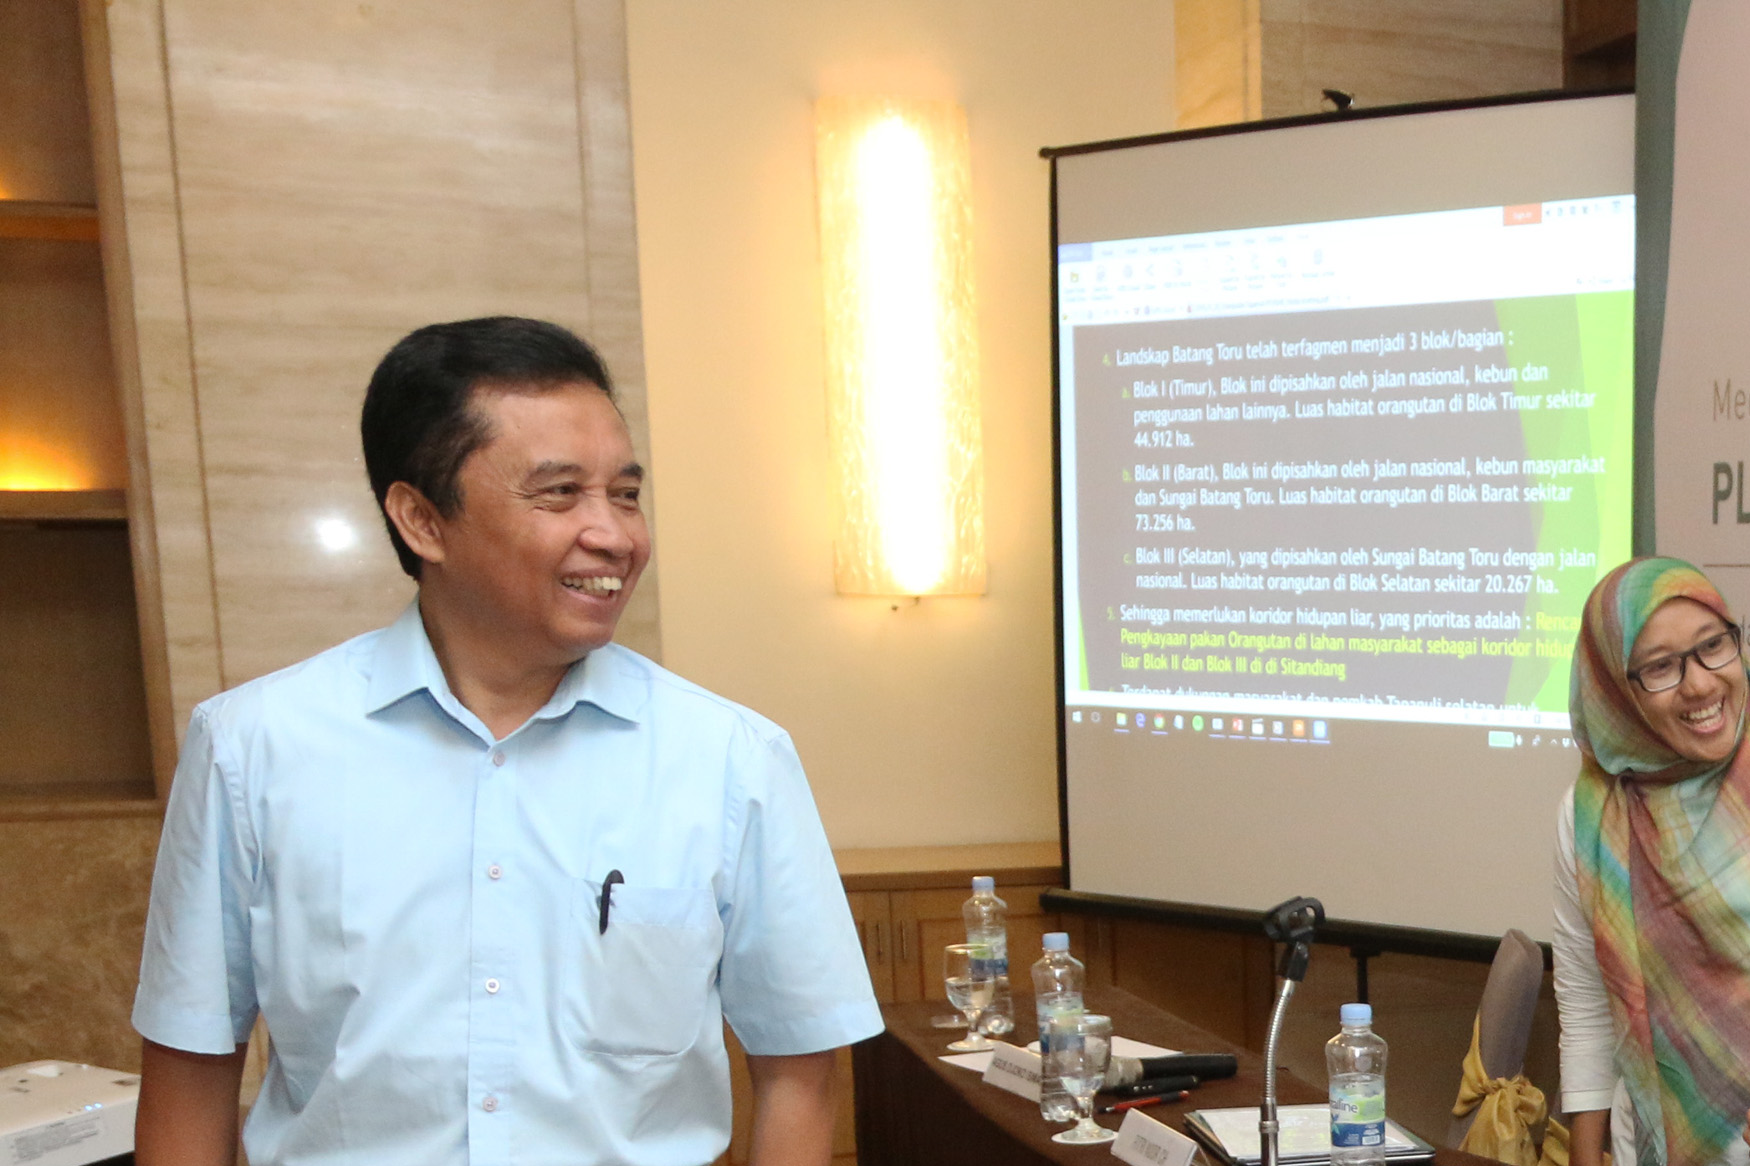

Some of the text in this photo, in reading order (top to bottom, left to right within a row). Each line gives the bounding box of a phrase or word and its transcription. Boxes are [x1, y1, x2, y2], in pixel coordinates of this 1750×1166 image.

[1116, 348, 1168, 366] Landskap
[1172, 345, 1214, 366] Batang
[1216, 343, 1242, 360] Toru
[1246, 341, 1277, 358] telah
[1282, 338, 1347, 360] terfagmen
[1352, 333, 1404, 356] menjadi
[1410, 332, 1417, 350] 3
[1422, 329, 1503, 351] blok/bagian
[1134, 381, 1157, 398] Blok
[1221, 377, 1246, 394] Blok
[1251, 376, 1265, 392] ini
[1269, 373, 1335, 395] dipisahkan
[1339, 371, 1367, 388] oleh
[1372, 370, 1405, 392] jalan
[1410, 366, 1470, 386] nasional,
[1475, 364, 1517, 383] kebun
[1522, 363, 1548, 381] dan
[1134, 390, 1597, 427] penggunaan lahan lainnya. Luas habitat orangutan di Blok Timur sekitar
[1134, 430, 1193, 447] 44.912 ha.
[1135, 464, 1159, 481] Blok
[1163, 464, 1169, 480] II
[1174, 464, 1218, 483] (Barat),
[1223, 463, 1248, 480] Blok
[1253, 463, 1268, 479] ini
[1271, 461, 1337, 482] dipisahkan
[1341, 460, 1369, 478] oleh
[1373, 459, 1406, 481] jalan
[1411, 458, 1470, 478] nasional,
[1476, 457, 1518, 474] kebun
[1523, 455, 1605, 478] masyarakat
[1135, 483, 1573, 510] dan Sungai Batang Toru. Luas habitat orangutan di Blok Barat sekitar
[1136, 514, 1195, 531] 73.256 ha.
[1136, 548, 1160, 564] Blok
[1164, 548, 1174, 564] III
[1178, 547, 1234, 567] (Selatan),
[1239, 551, 1267, 569] yang
[1271, 549, 1337, 568] dipisahkan
[1340, 549, 1368, 565] oleh
[1373, 548, 1414, 570] Sungai
[1419, 549, 1465, 570] Batang
[1469, 548, 1498, 566] Toru
[1503, 548, 1554, 570] dengan
[1558, 550, 1595, 571] jalan
[1136, 572, 1558, 595] nasional. Luas habitat orangutan di Blok Selatan sekitar 20.267 ha.
[1120, 604, 1169, 625] Sehingga
[1174, 607, 1245, 624] memerlukan
[1249, 607, 1292, 625] koridor
[1297, 608, 1346, 629] hidupan
[1350, 609, 1374, 628] liar,
[1379, 613, 1410, 631] yang
[1414, 612, 1470, 630] prioritas
[1475, 612, 1520, 629] adalah
[1536, 612, 1582, 630] Renca
[1121, 628, 1574, 660] Pengkayaan pakan Orangutan di lahan masyarakat sebagai koridor hidup
[1121, 653, 1139, 669] liar
[1144, 655, 1167, 670] Blok
[1172, 656, 1178, 670] II
[1182, 656, 1203, 671] dan
[1207, 656, 1232, 672] Blok
[1236, 657, 1246, 673] III
[1250, 657, 1262, 673] di
[1266, 657, 1278, 674] di
